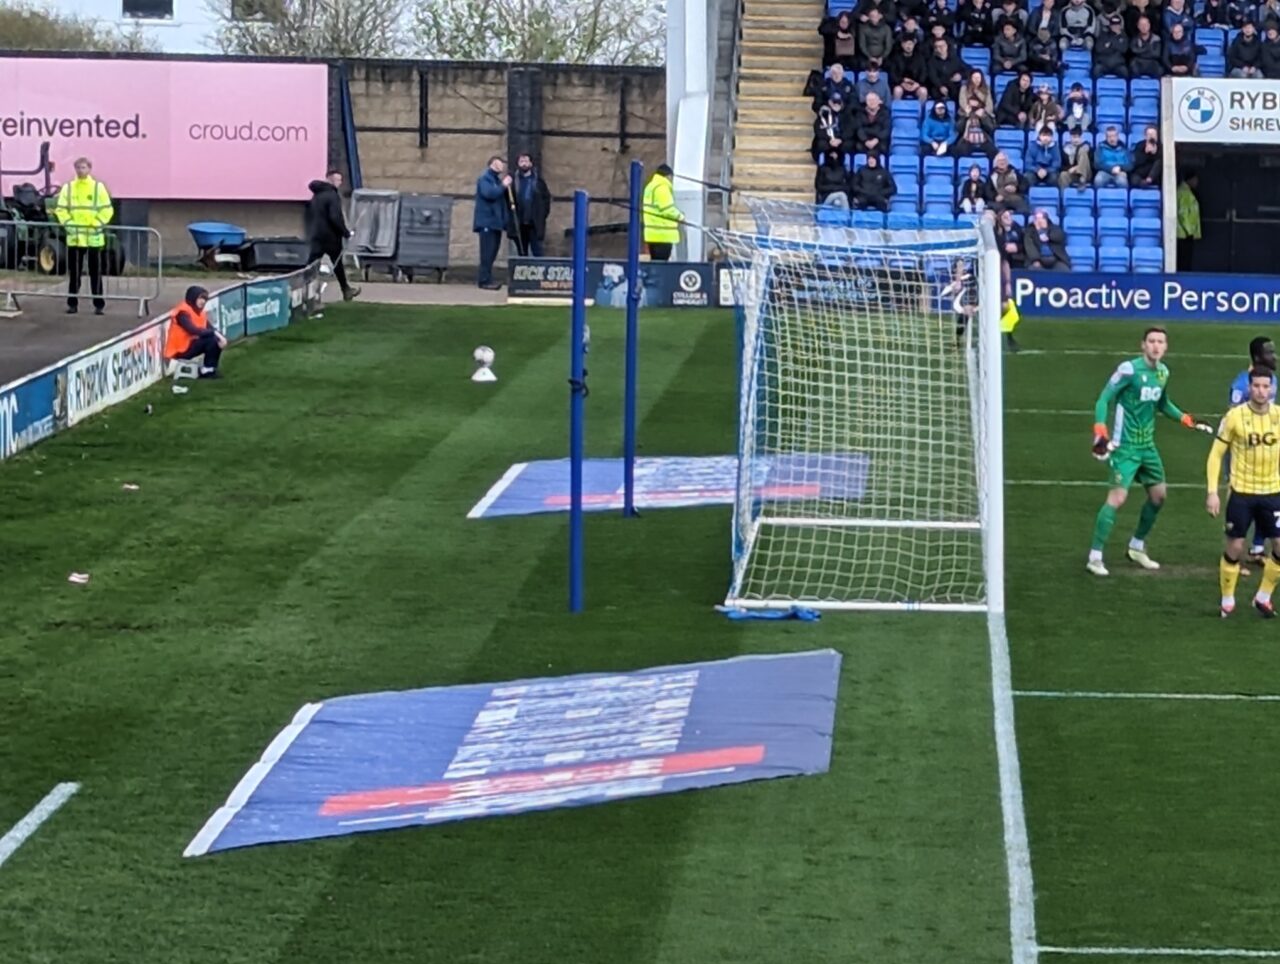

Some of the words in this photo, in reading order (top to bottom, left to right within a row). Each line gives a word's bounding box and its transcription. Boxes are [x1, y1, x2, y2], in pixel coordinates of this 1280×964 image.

[0, 111, 147, 139] einvented.
[189, 120, 308, 141] croud.com
[1015, 278, 1151, 310] Proactive
[1248, 432, 1277, 446] BG
